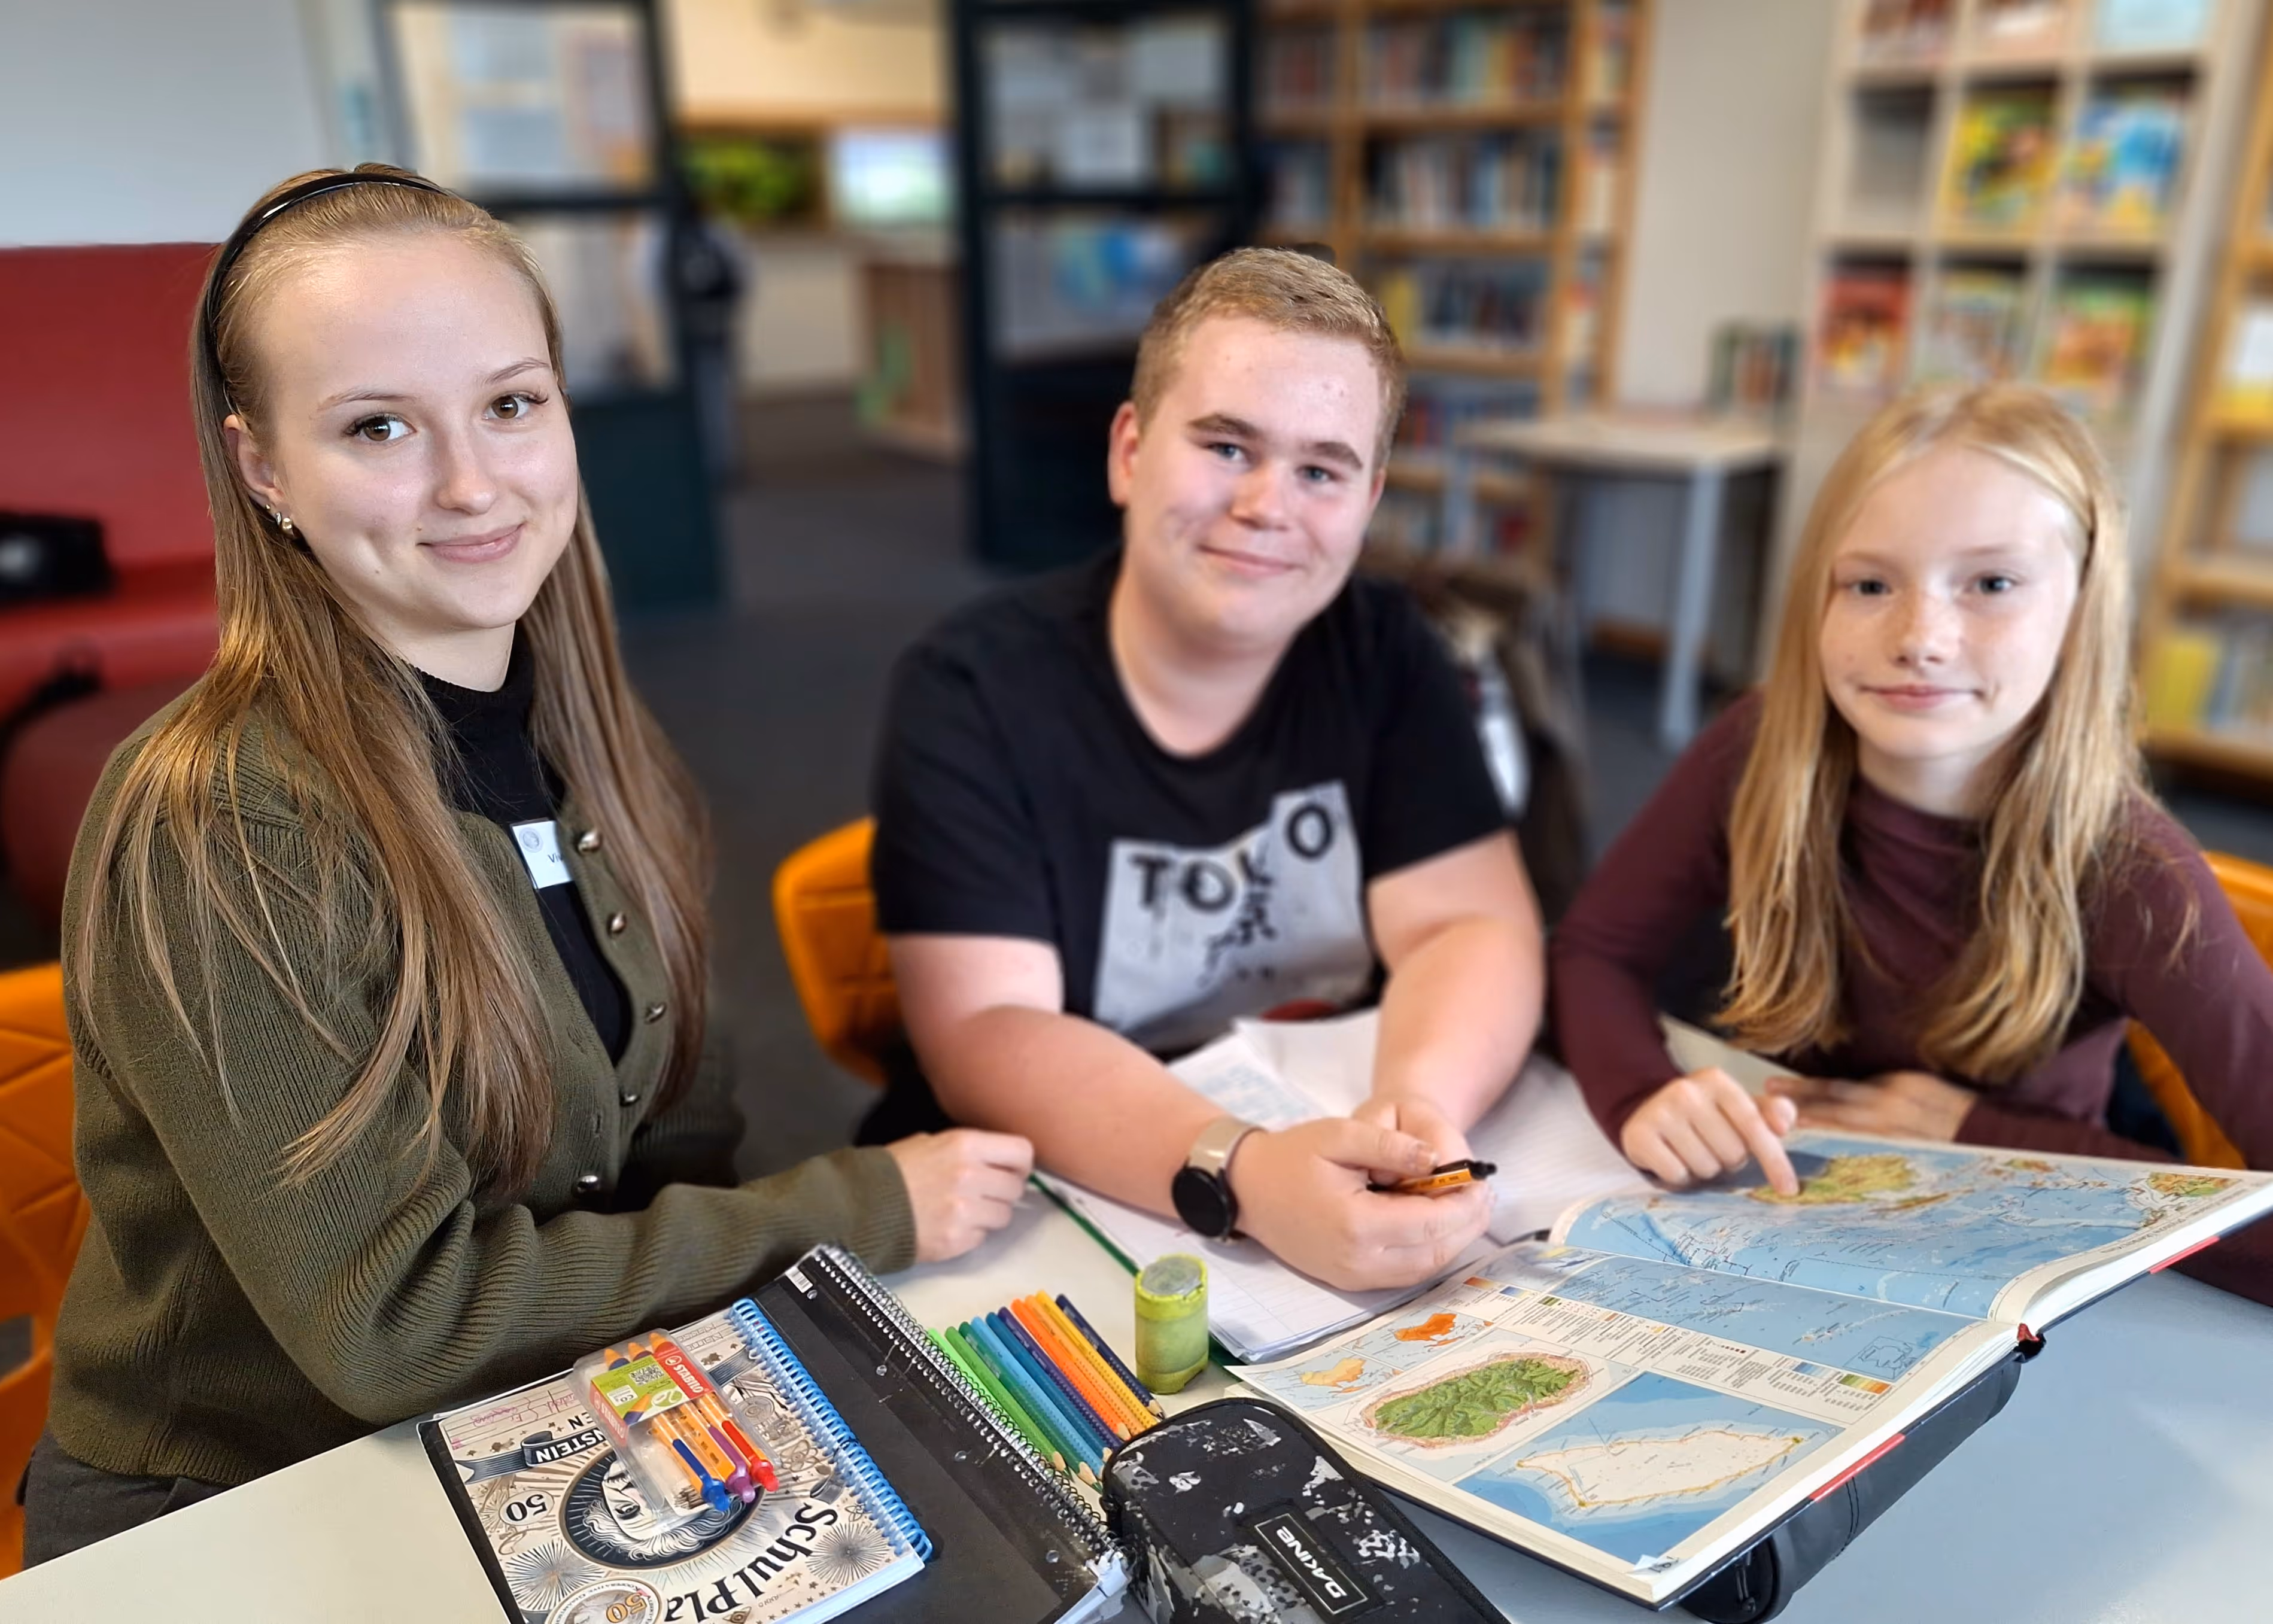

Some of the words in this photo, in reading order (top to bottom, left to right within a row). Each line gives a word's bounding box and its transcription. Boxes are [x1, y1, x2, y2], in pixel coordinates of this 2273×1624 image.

[673, 1363, 704, 1394] STABILO
[536, 1428, 607, 1463] NSTEIN
[506, 1494, 547, 1521] 50
[1277, 1526, 1348, 1598] DAKINE
[606, 1593, 647, 1623] 50
[664, 1577, 743, 1623] Pla
